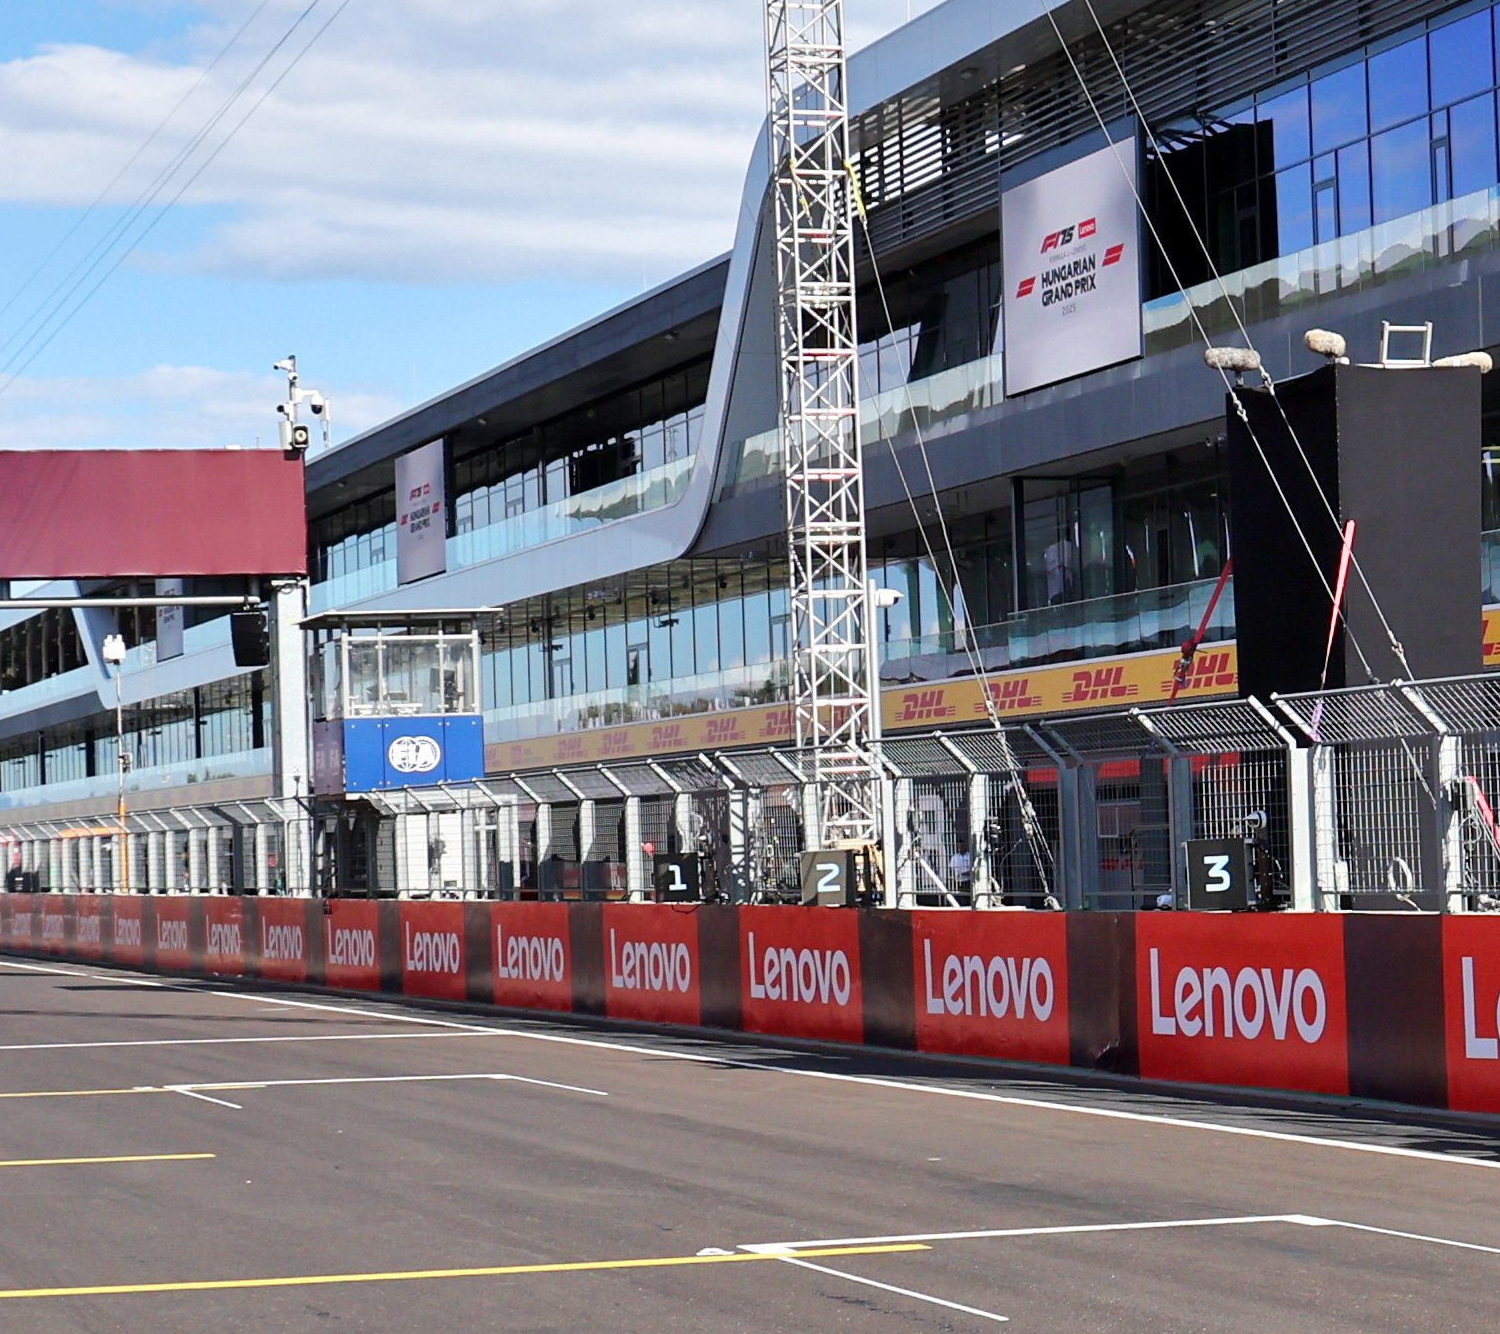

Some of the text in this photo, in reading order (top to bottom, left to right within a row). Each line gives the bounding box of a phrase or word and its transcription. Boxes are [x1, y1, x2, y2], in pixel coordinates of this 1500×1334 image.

[1041, 254, 1096, 289] HUNGARIAN
[1041, 273, 1097, 307] GRAND PRIX
[985, 679, 1033, 709] DHL
[1072, 667, 1128, 702] DHL
[902, 689, 949, 721] DHL
[706, 716, 741, 743] DHL
[668, 865, 687, 891] 1
[816, 864, 841, 891] 2
[1203, 855, 1231, 892] 3
[114, 911, 141, 946] Lenovo
[157, 913, 188, 951] Lenovo
[206, 914, 241, 956] Lenovo
[263, 915, 303, 960] Lenovo
[328, 918, 375, 967] Lenovo
[406, 920, 460, 974] Lenovo
[498, 923, 564, 982] Lenovo
[610, 928, 690, 993] Lenovo
[748, 932, 851, 1006] Lenovo
[924, 939, 1054, 1022] Lenovo
[1150, 947, 1327, 1044] Lenovo
